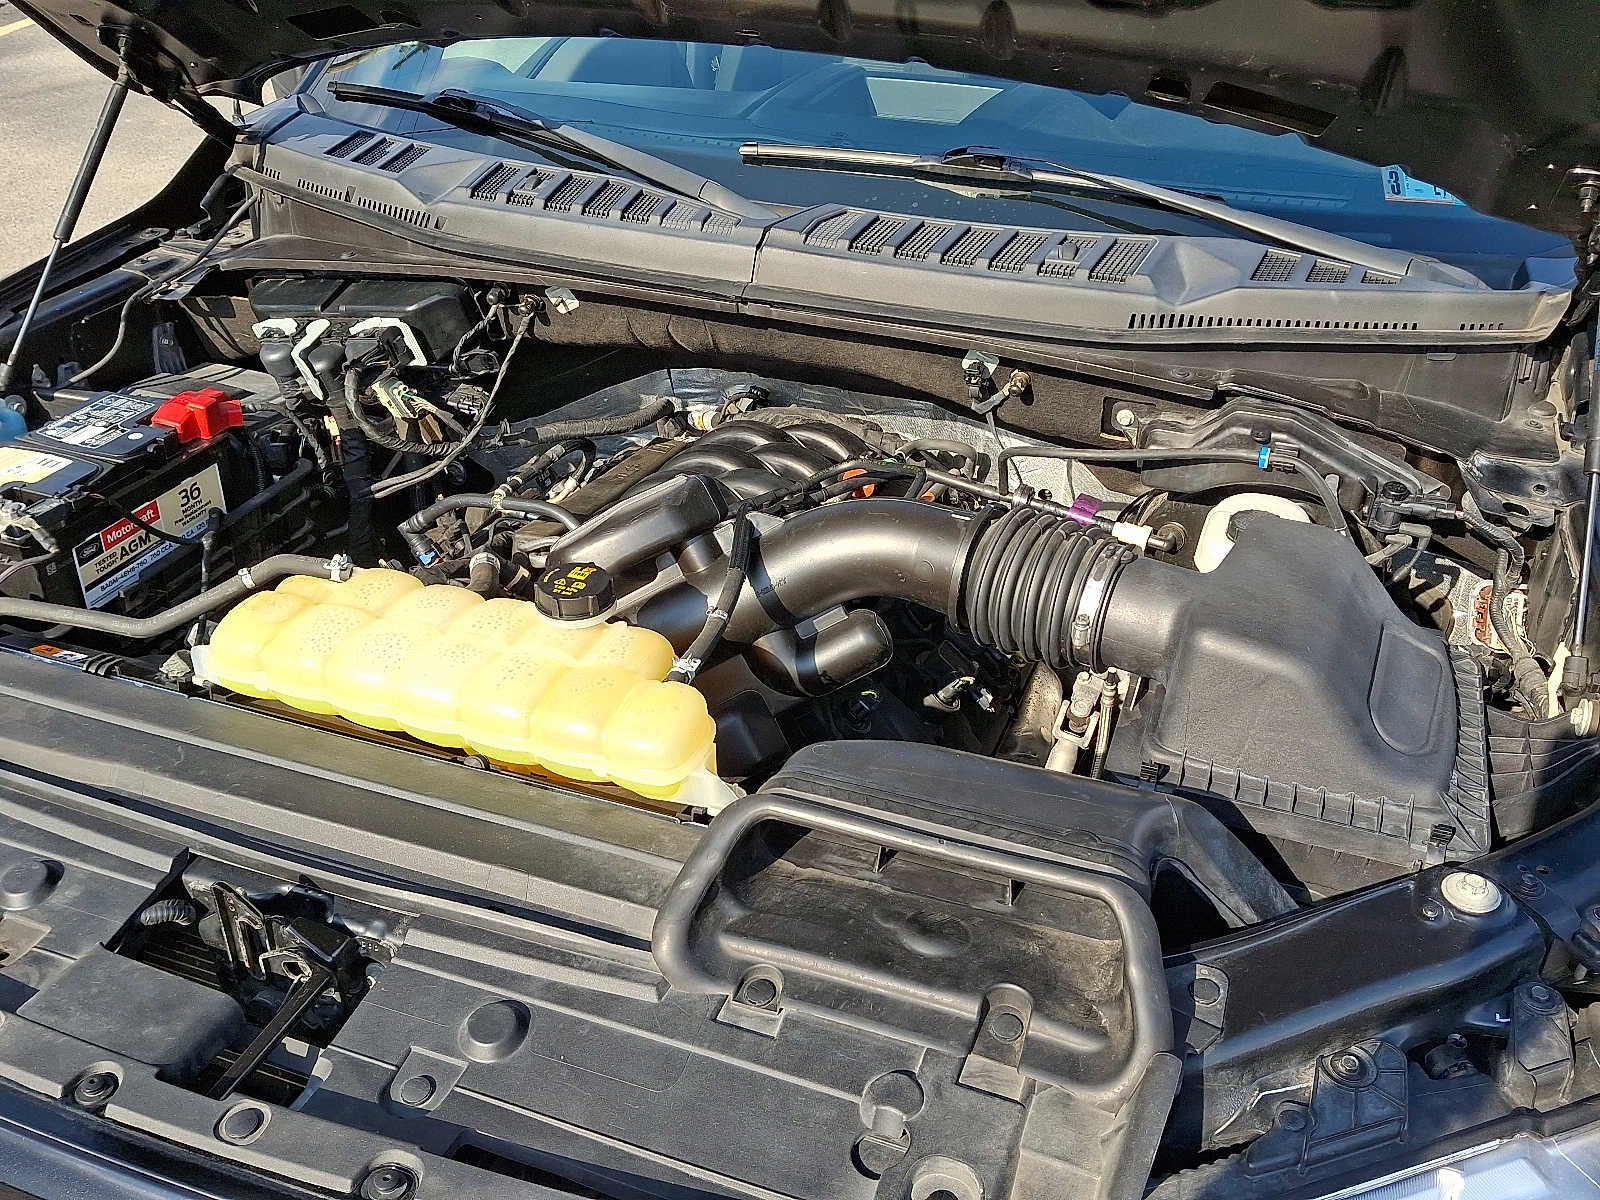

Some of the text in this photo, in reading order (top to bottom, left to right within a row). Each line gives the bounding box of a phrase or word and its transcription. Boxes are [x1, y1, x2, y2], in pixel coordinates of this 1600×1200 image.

[1388, 170, 1402, 196] 3
[178, 481, 201, 508] 36
[182, 498, 203, 514] MONTH
[106, 509, 154, 543] Motoraft
[181, 508, 207, 527] WARRANTY
[119, 532, 152, 560] AGM
[160, 542, 174, 553] CCA
[94, 551, 117, 568] TESTED
